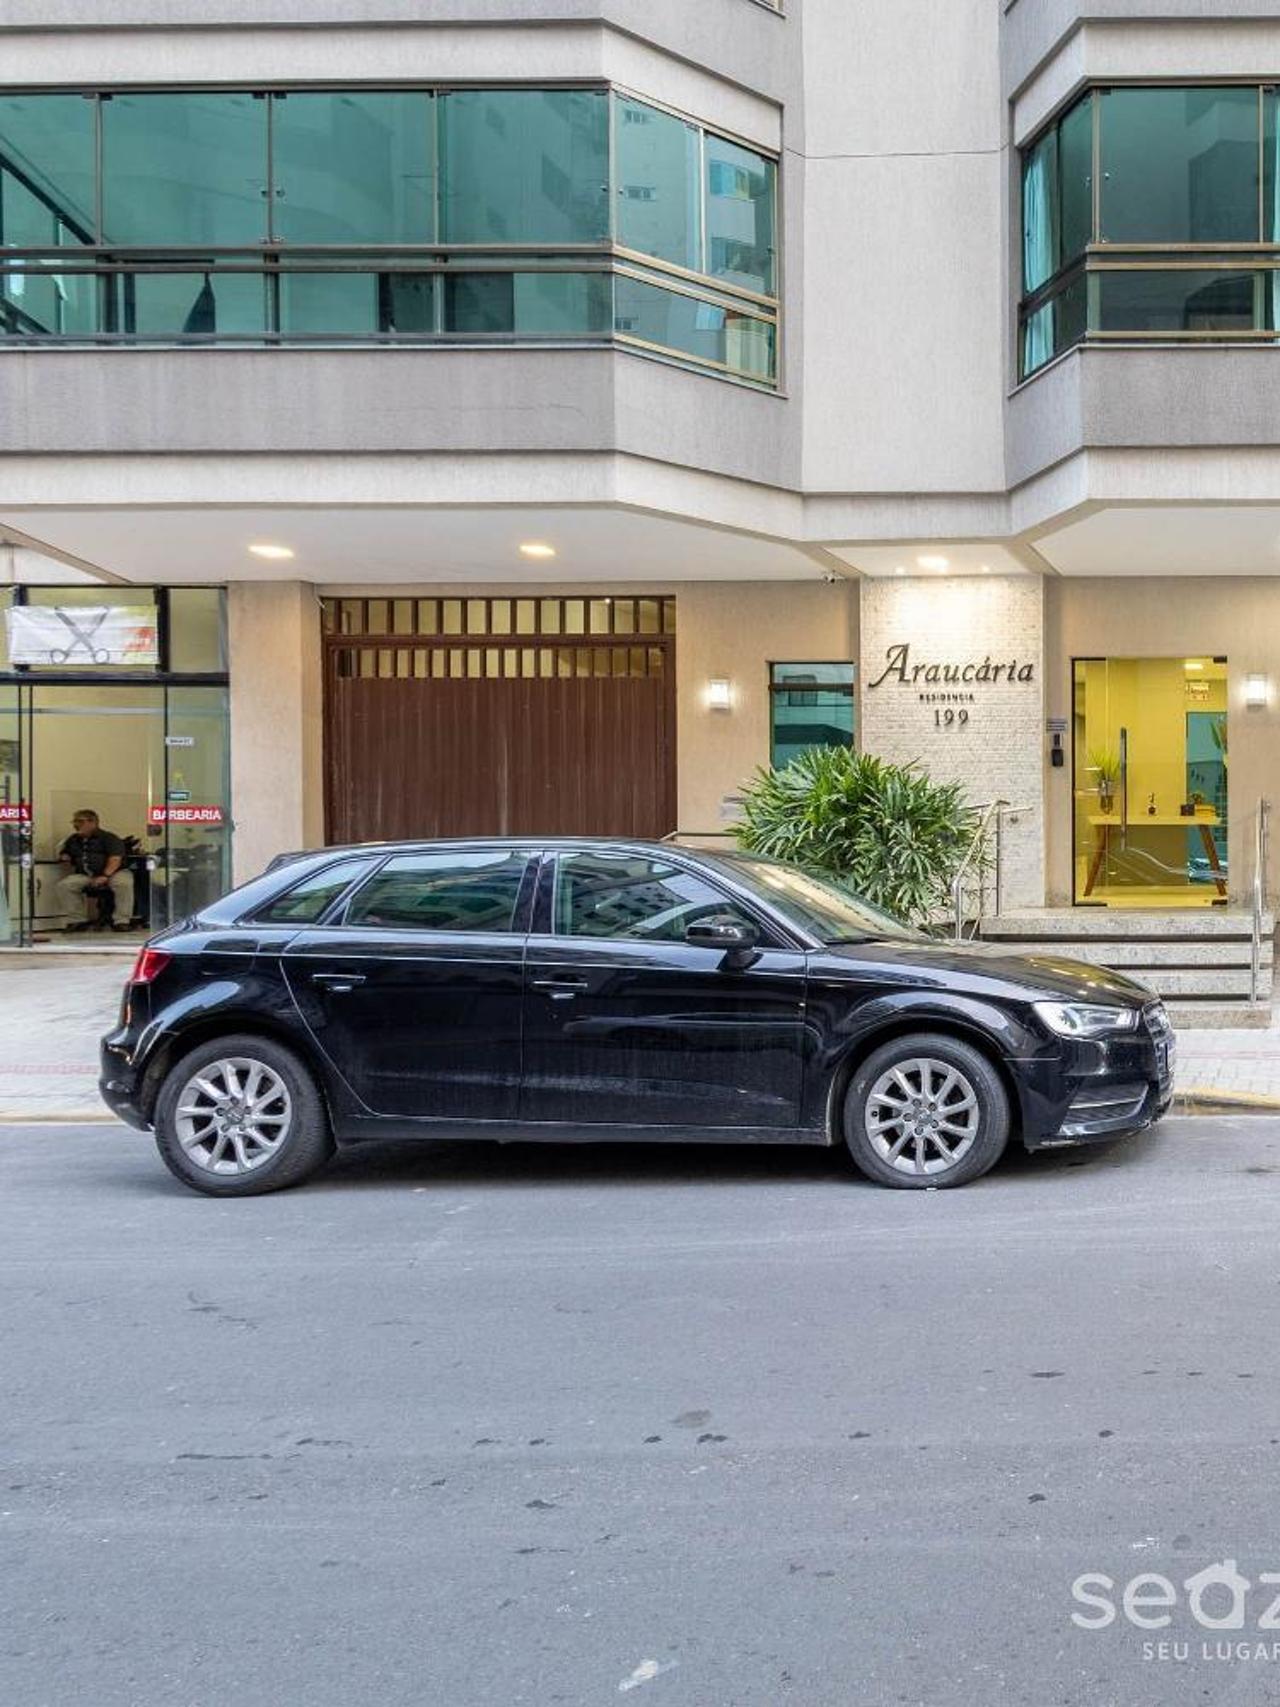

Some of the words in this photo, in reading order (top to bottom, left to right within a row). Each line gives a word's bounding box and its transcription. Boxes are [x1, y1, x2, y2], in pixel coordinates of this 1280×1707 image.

[868, 643, 1034, 688] Araucária
[934, 708, 969, 727] 199
[152, 809, 222, 820] BARBEARIA
